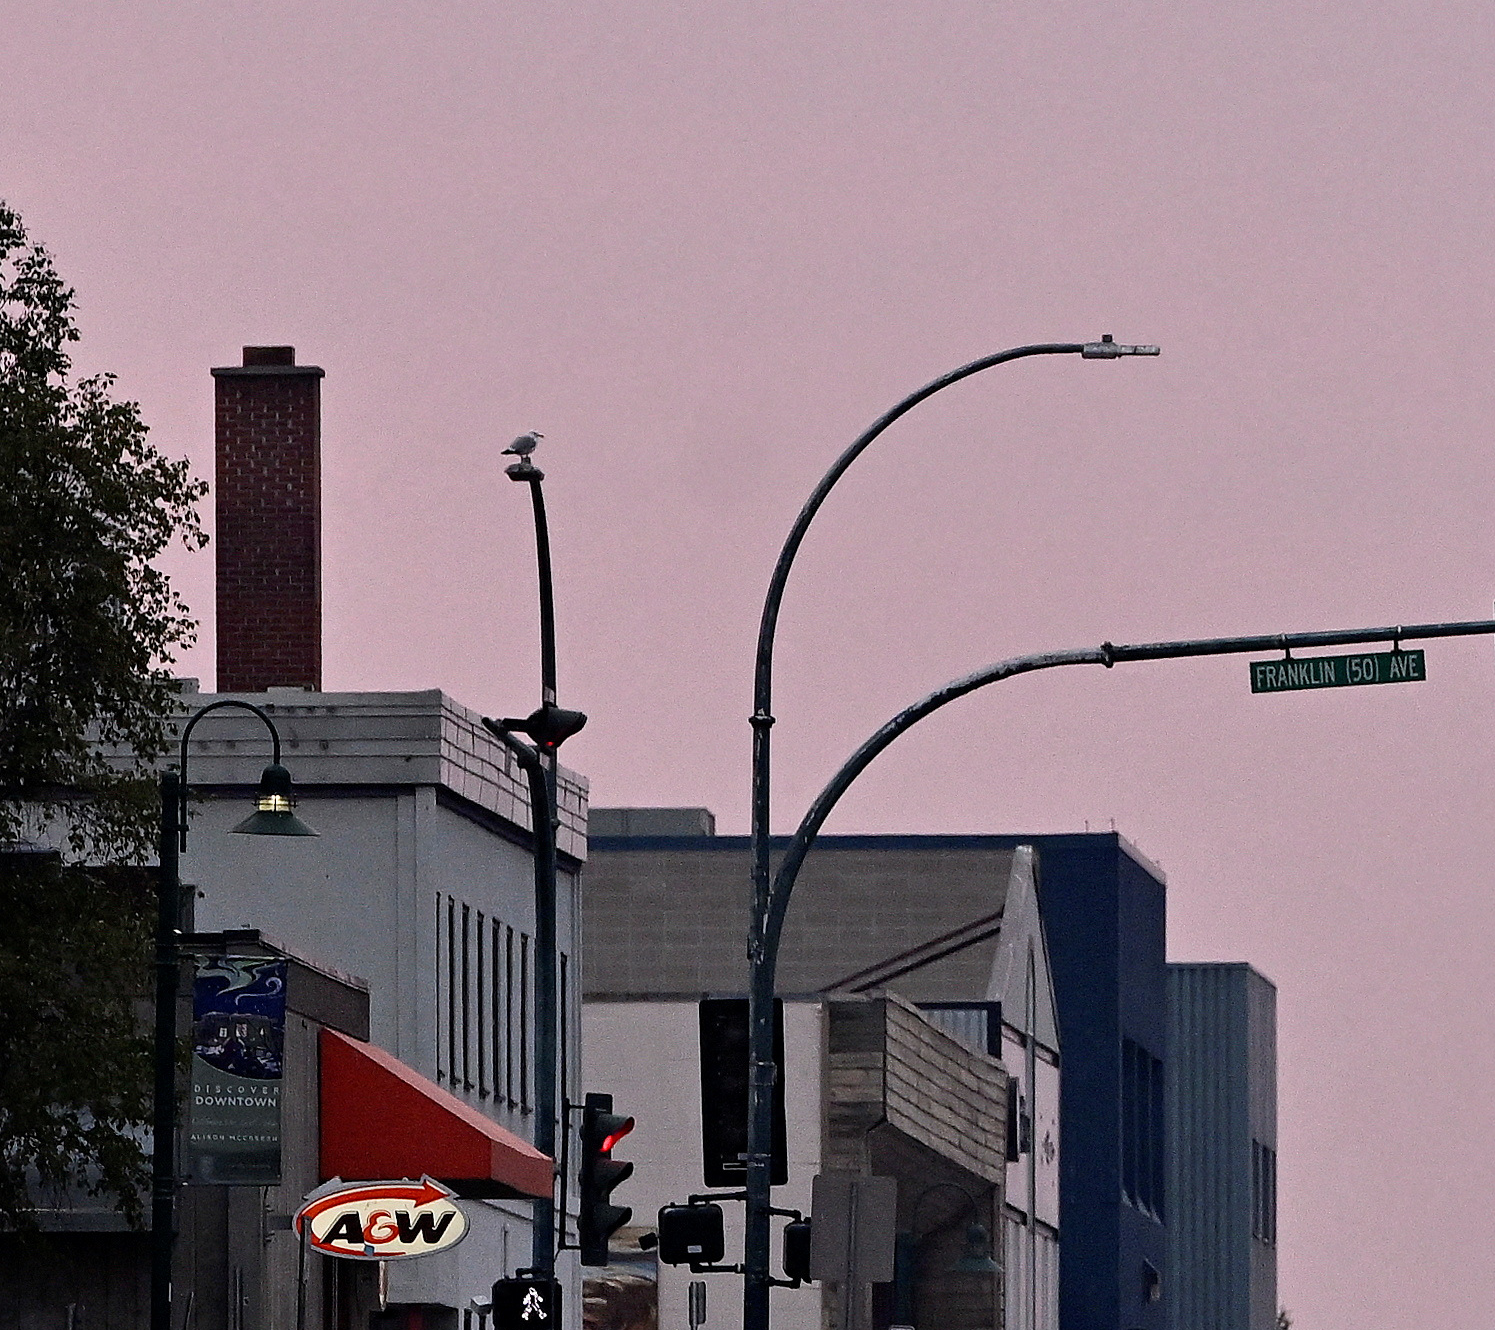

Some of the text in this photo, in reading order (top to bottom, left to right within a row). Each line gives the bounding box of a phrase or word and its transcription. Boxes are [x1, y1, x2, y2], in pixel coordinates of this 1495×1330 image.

[1256, 654, 1419, 689] FRANKLIN (50) AVE
[194, 1084, 280, 1095] DISCOVER
[195, 1095, 278, 1107] DOWNTOWN
[319, 1209, 456, 1244] A&W
